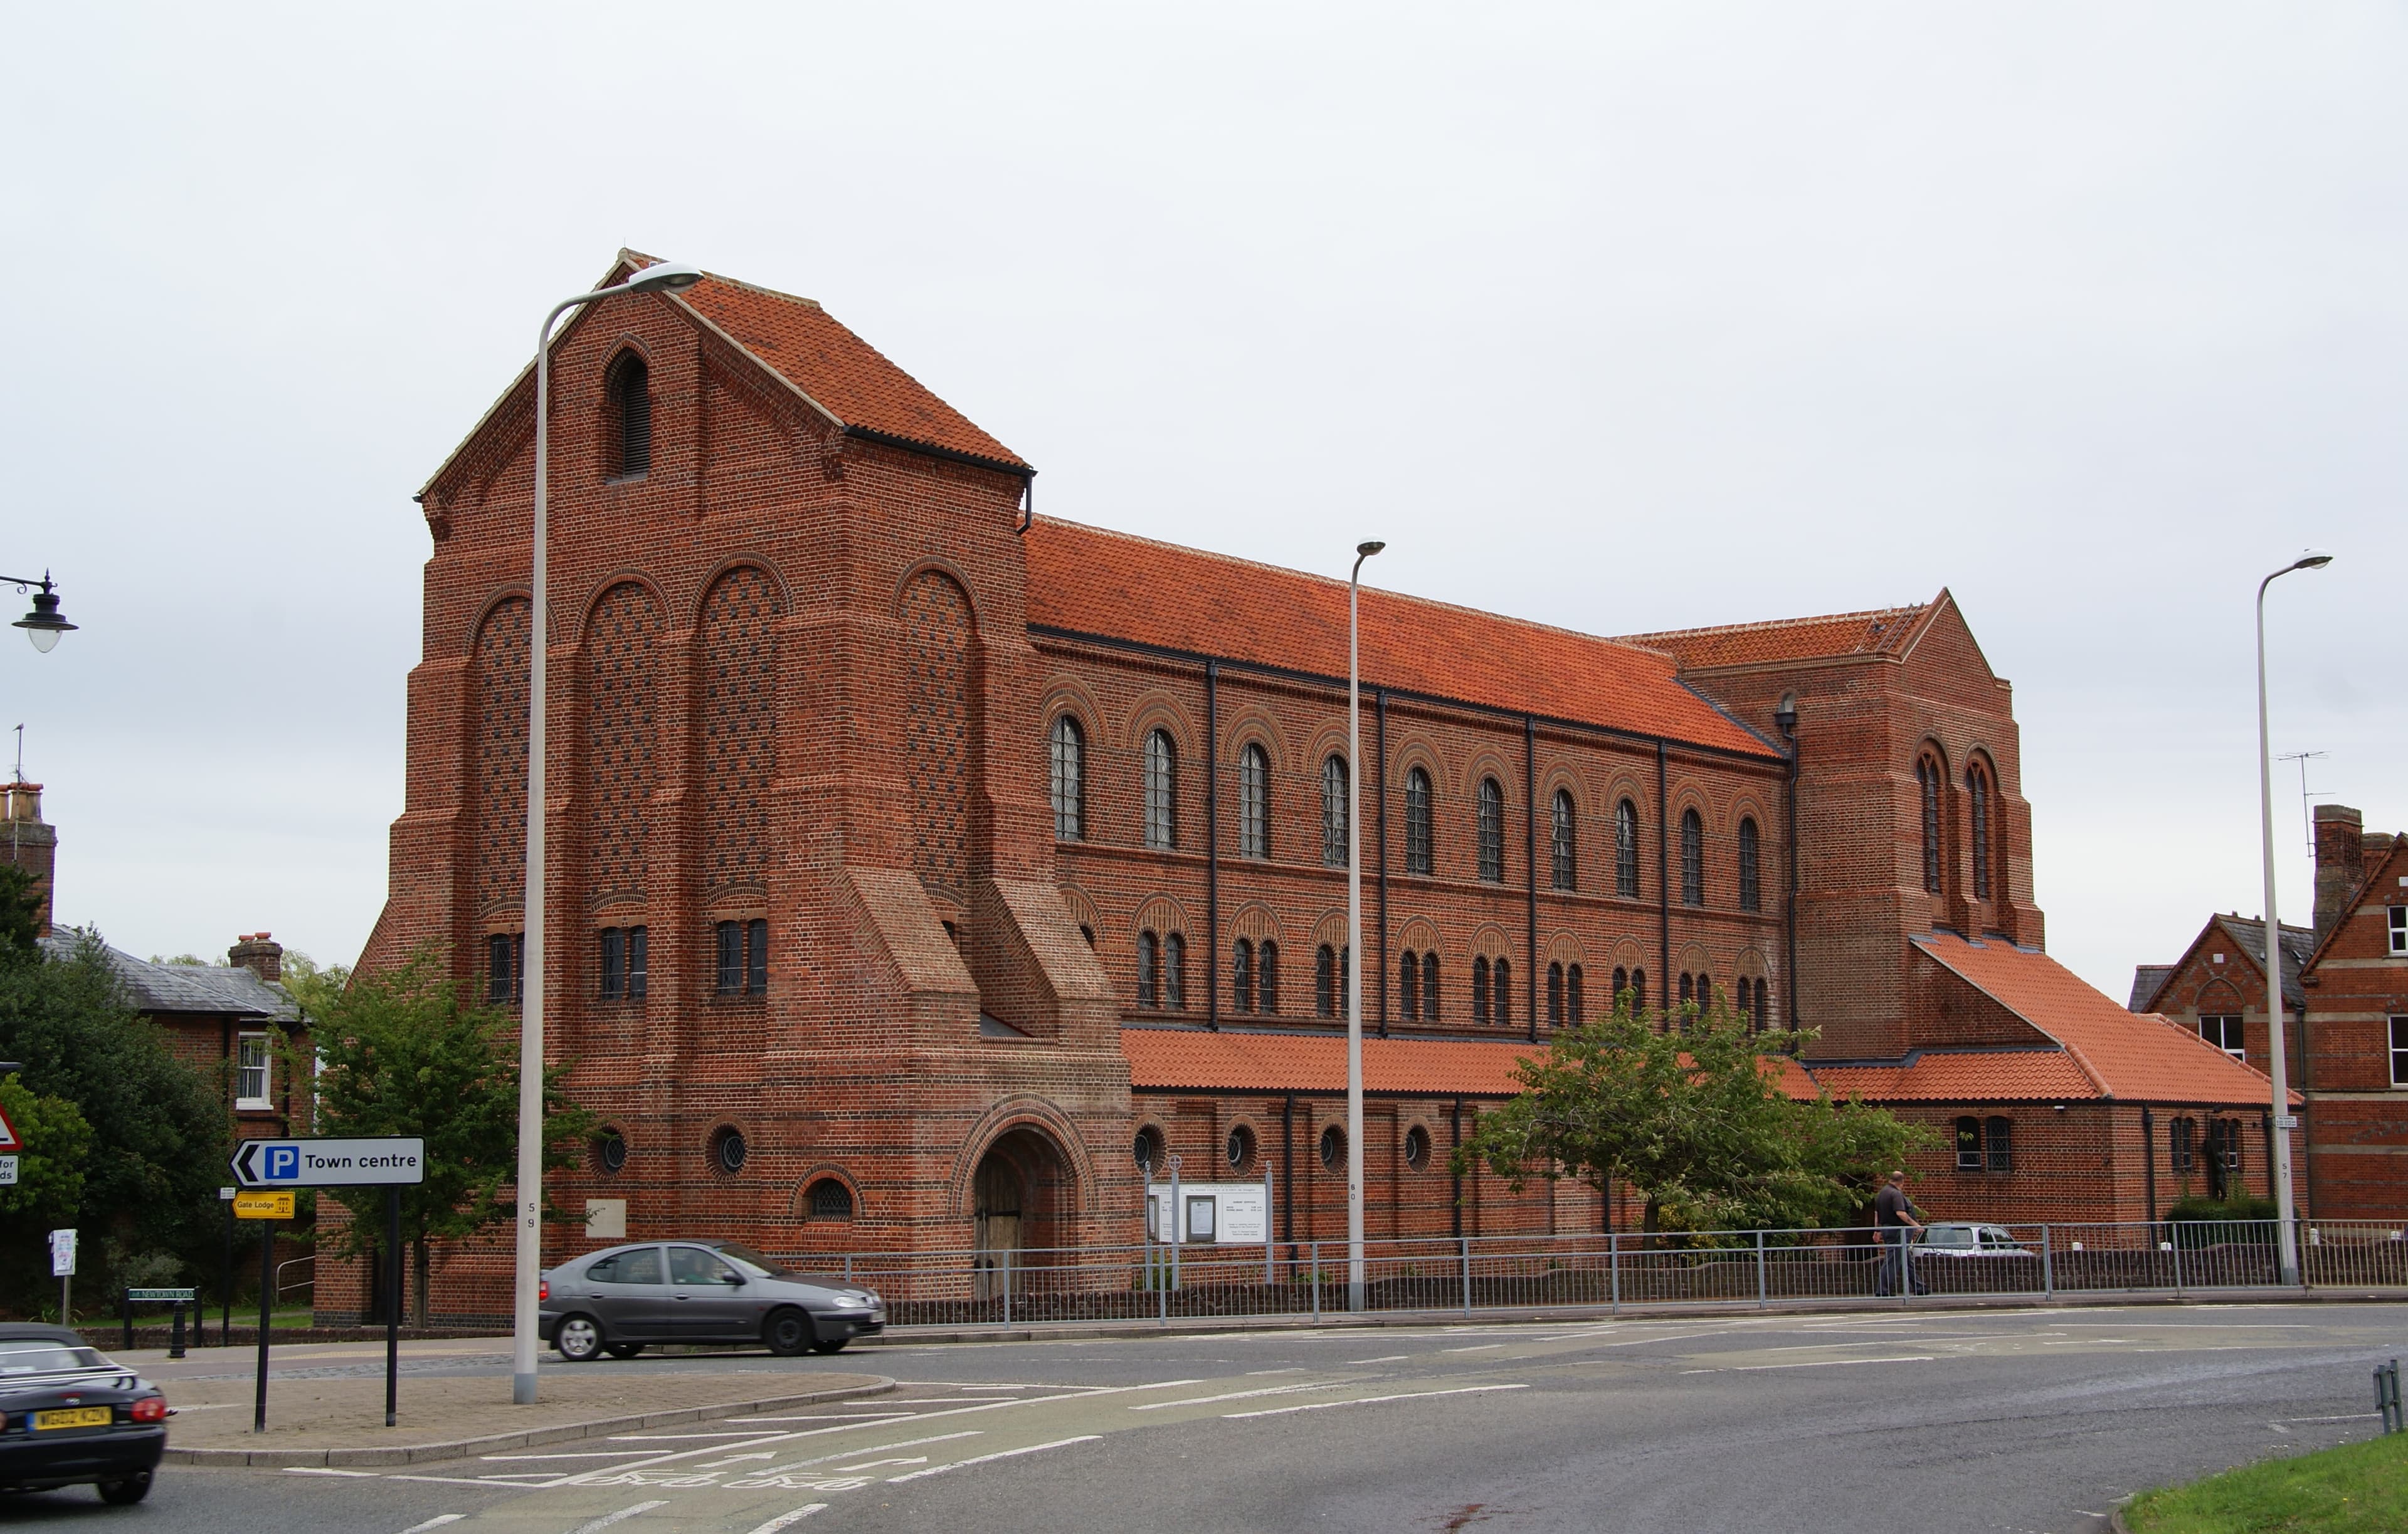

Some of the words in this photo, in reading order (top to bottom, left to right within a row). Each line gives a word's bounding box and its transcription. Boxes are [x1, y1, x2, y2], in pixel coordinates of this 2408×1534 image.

[273, 1150, 294, 1176] P
[305, 1155, 351, 1168] Town
[359, 1154, 416, 1168] centre
[255, 1201, 274, 1210] Lodge
